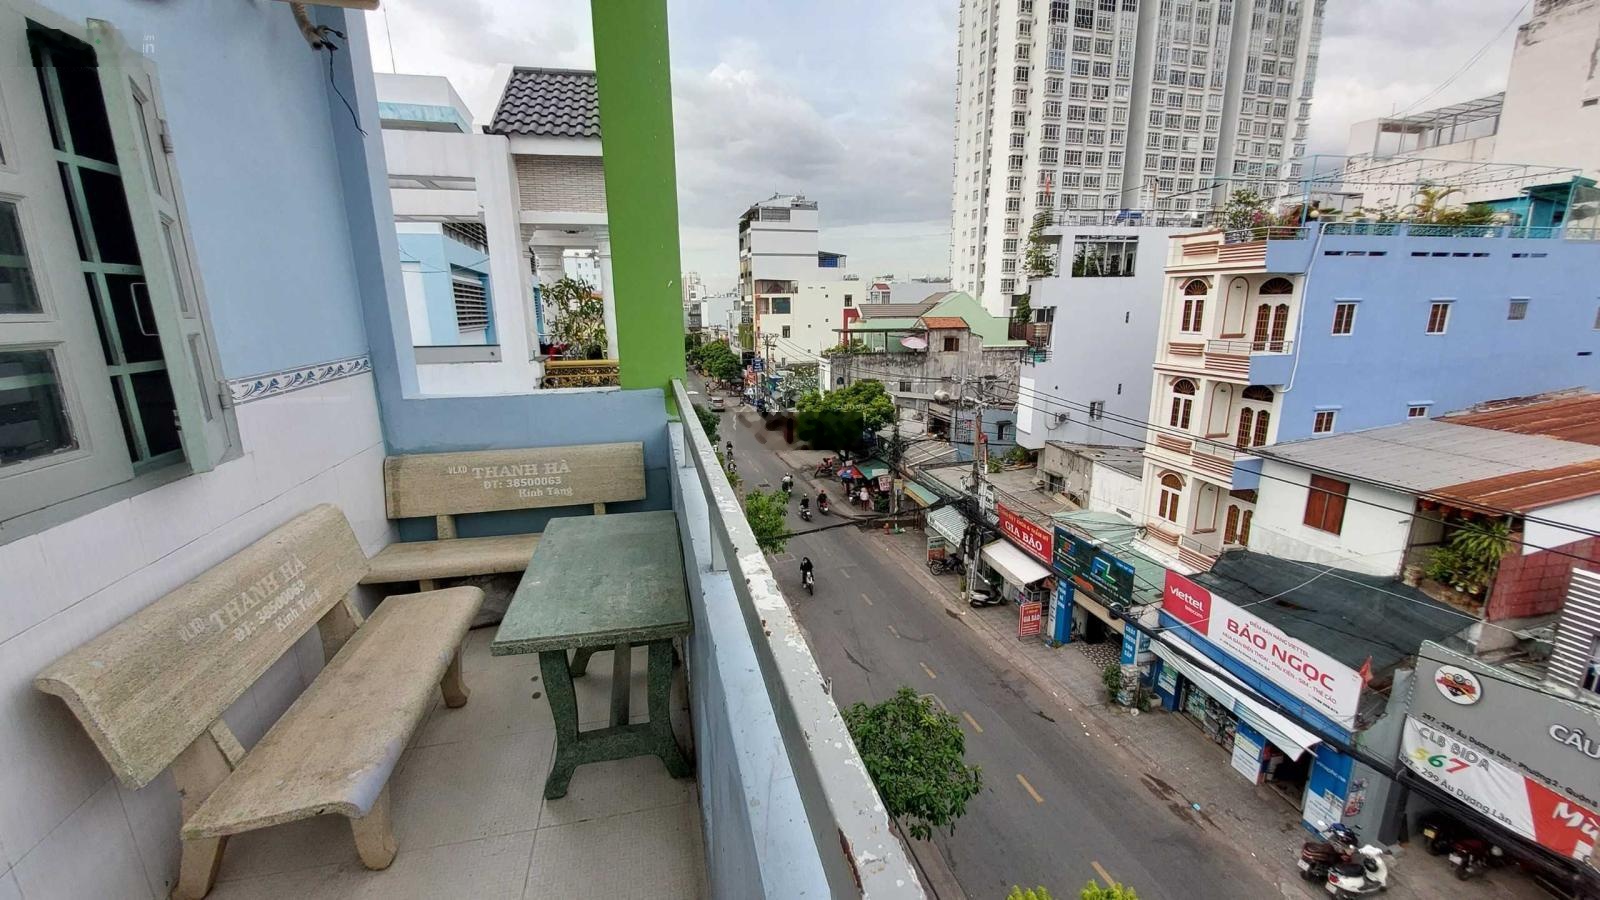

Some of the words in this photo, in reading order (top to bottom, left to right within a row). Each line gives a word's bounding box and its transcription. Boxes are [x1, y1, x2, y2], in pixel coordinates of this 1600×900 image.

[472, 463, 539, 479] THANH
[544, 459, 572, 475] HÀ
[506, 476, 562, 488] 38500063
[1004, 520, 1021, 539] GIA
[1022, 531, 1043, 551] BẢO
[209, 573, 280, 634] THANH
[1170, 585, 1204, 612] viettel
[1227, 617, 1267, 650] BẢO
[1271, 643, 1335, 692] NGỌC
[1419, 727, 1446, 748] CLB
[1450, 742, 1490, 772] BIDA
[1549, 723, 1600, 759] CÂU
[1420, 767, 1440, 782] 299
